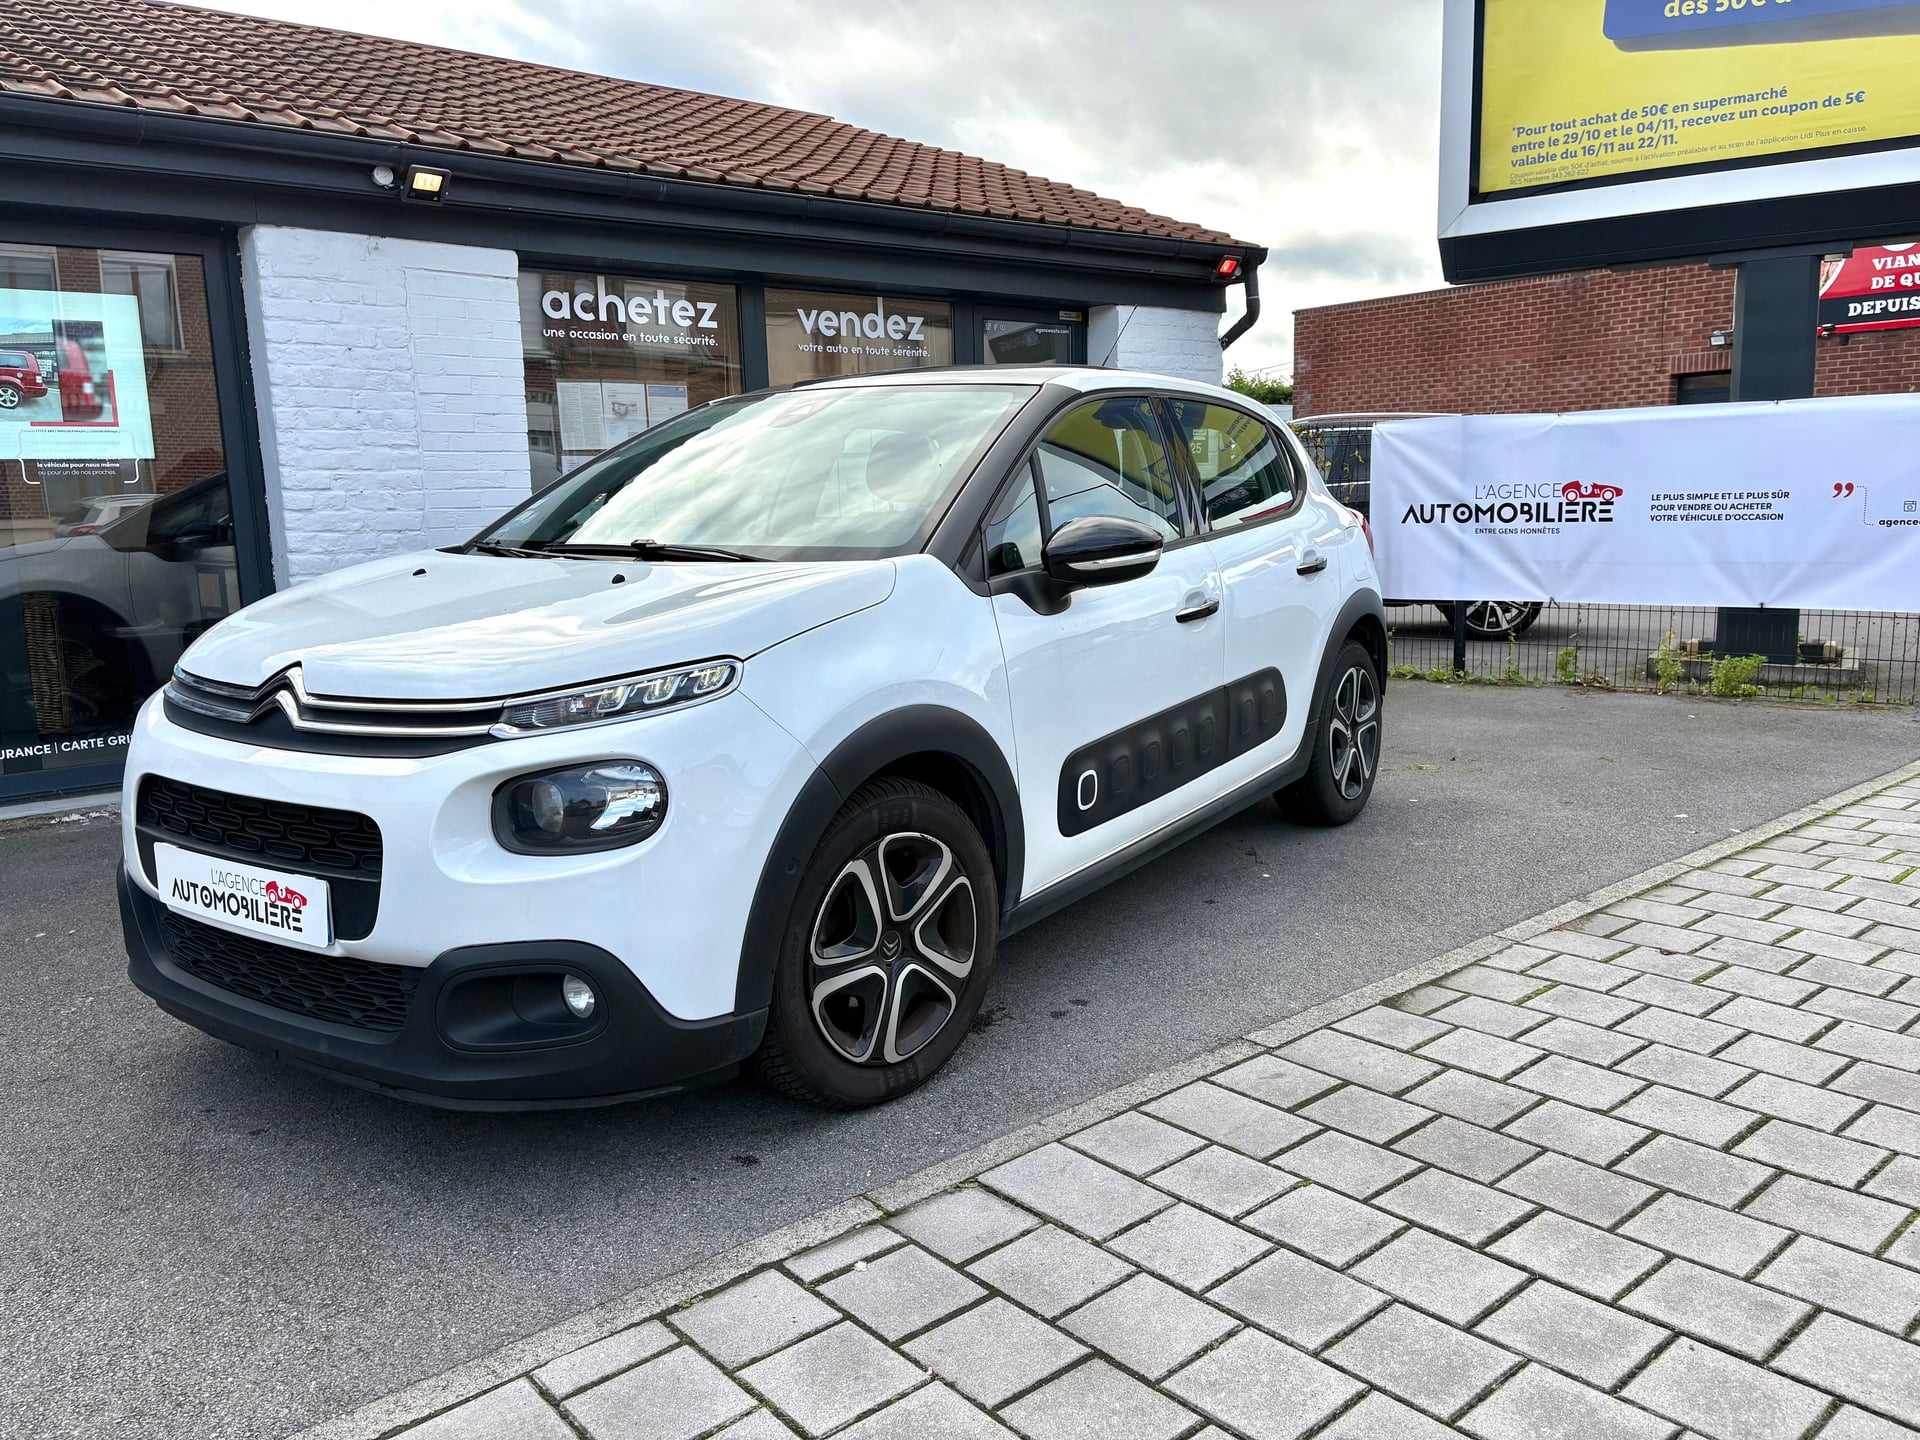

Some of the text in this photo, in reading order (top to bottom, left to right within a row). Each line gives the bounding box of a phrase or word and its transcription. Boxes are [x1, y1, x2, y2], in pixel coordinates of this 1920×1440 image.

[1550, 118, 1577, 132] tout
[1580, 112, 1617, 127] achat
[1620, 109, 1638, 121] de
[1641, 104, 1669, 118] 50€
[1672, 103, 1689, 113] en
[1693, 86, 1788, 112] supermarché
[1511, 90, 1866, 153] entre le 29/10 et le 04/11, recevez un coupon de 5€
[1756, 134, 1799, 146] l'application
[1800, 131, 1814, 140] Lidl
[1843, 126, 1868, 134] caisse.
[1511, 133, 1678, 168] valable du 16/11 au 22/11.
[1871, 275, 1895, 289] DE
[541, 275, 718, 329] achetez
[1848, 296, 1920, 316] DEPUIS
[796, 296, 925, 341] vendez
[543, 328, 719, 346] une occasion en toute sécurité.
[798, 343, 930, 358] votre auto en toute sérénité.
[1475, 482, 1562, 499] L'AGENCE
[1663, 493, 1685, 501] PLUS
[1721, 492, 1732, 500] ET
[1746, 491, 1770, 499] PLUS
[1771, 489, 1790, 499] SÛR
[1677, 503, 1712, 511] VENDRE
[1714, 503, 1728, 511] OU
[1729, 502, 1772, 510] ACHETER
[1650, 511, 1784, 522] VOTRE VÉHICULE D'OCCASION
[1879, 519, 1920, 527] agence
[1475, 526, 1560, 535] ENTRE GENS HONNÊTES
[61, 737, 105, 752] CARTE
[107, 734, 132, 746] GRI
[210, 868, 267, 897] L'AGENCE
